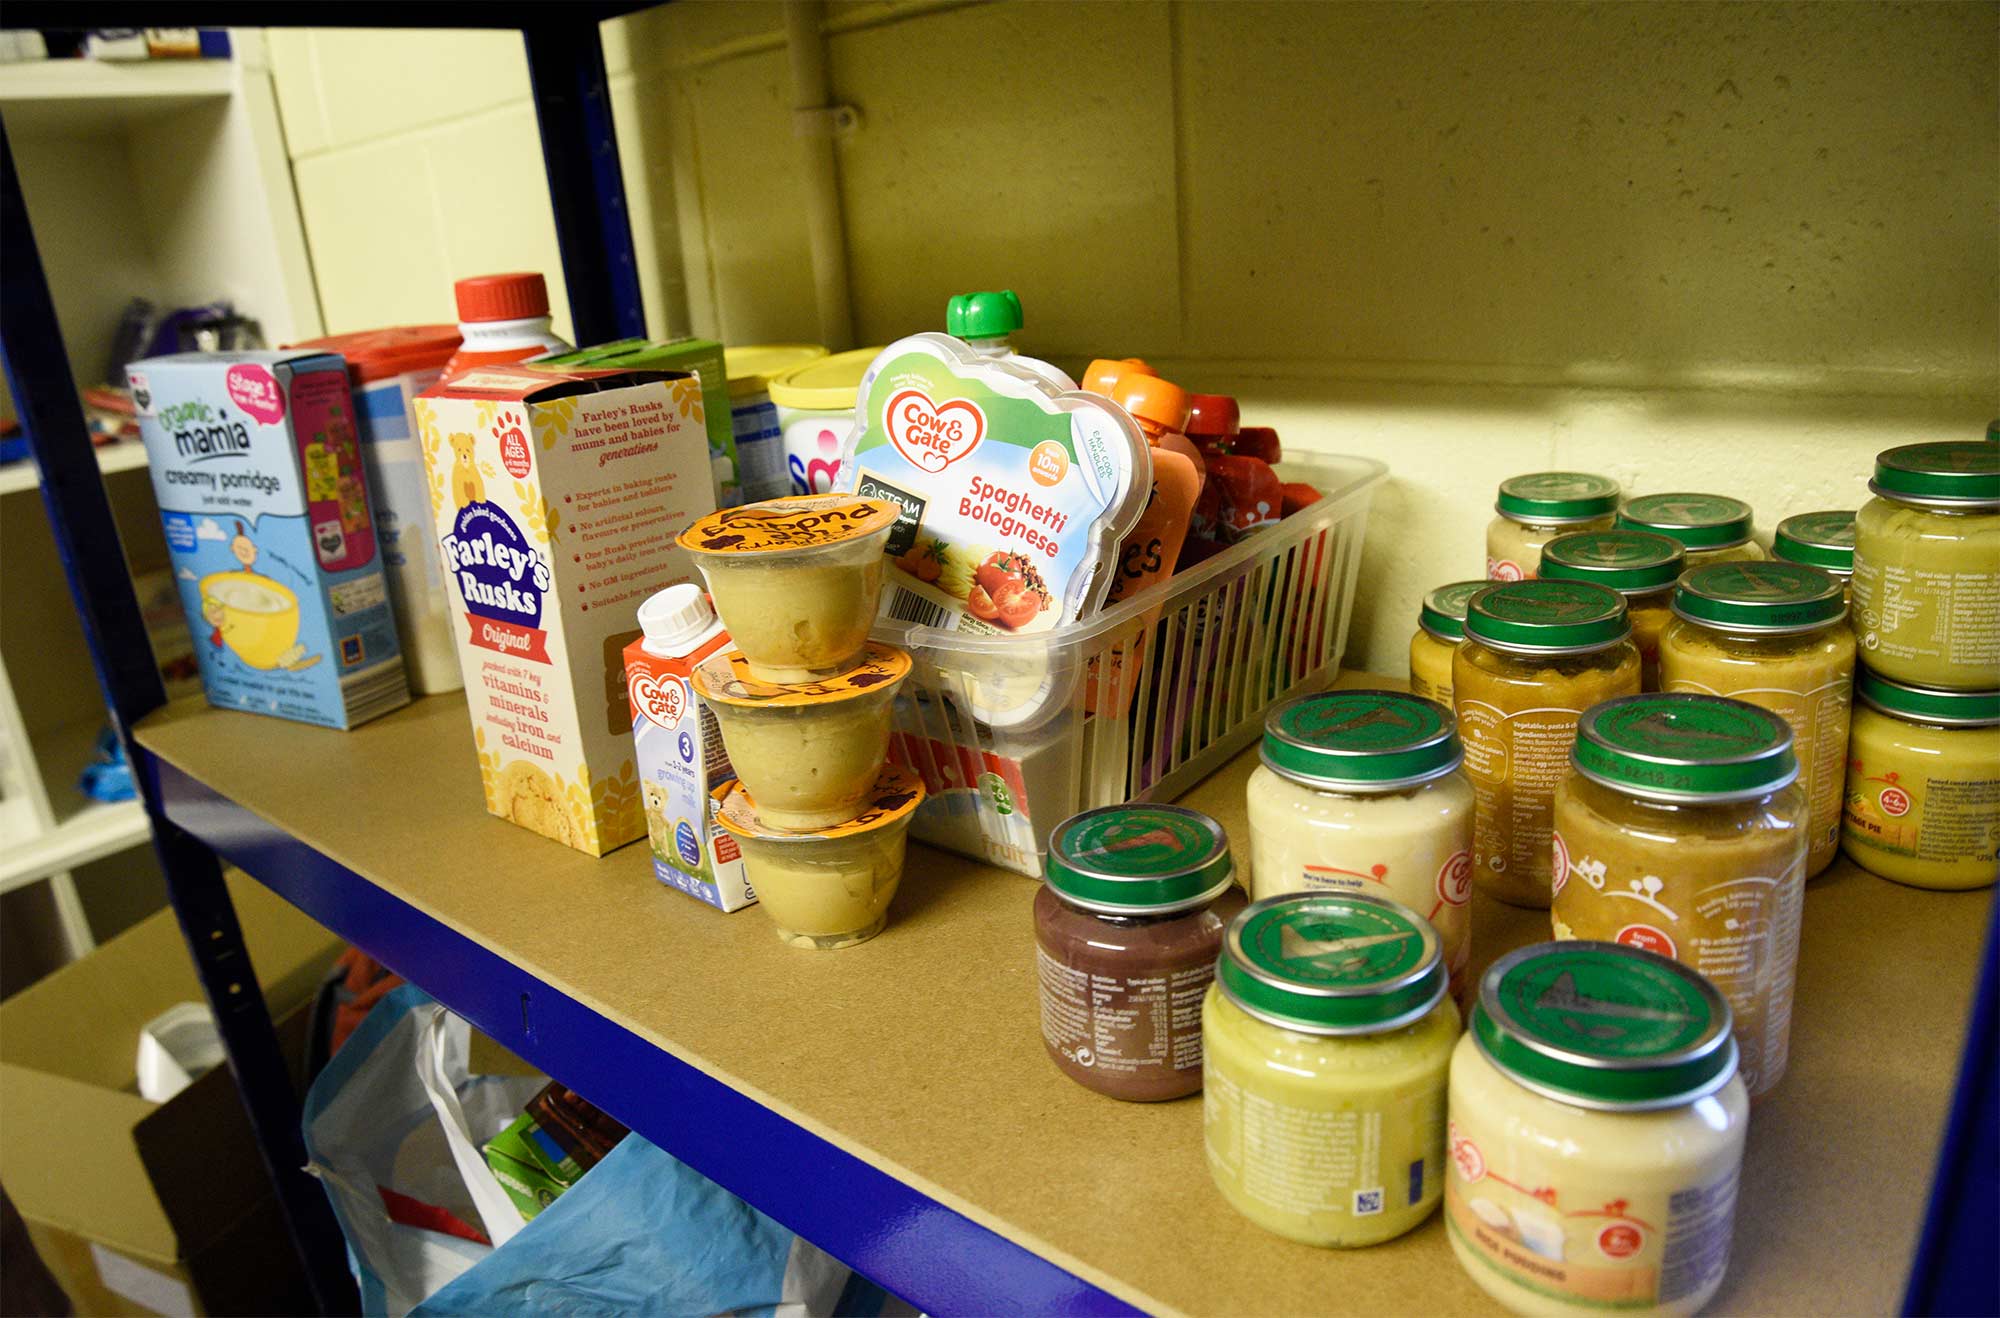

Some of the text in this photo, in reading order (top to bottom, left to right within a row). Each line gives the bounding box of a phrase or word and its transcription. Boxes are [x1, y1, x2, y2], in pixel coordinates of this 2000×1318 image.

[229, 371, 264, 395] Stage
[267, 380, 277, 400] 1
[159, 398, 215, 432] organic
[574, 411, 674, 439] have been loved by
[582, 401, 663, 423] Farley's Rusks
[904, 403, 963, 441] Cow &
[174, 410, 250, 457] mamia
[506, 433, 521, 447] ALL
[571, 422, 681, 452] mums and babies for
[905, 425, 951, 454] Gate
[504, 446, 526, 459] AGES
[598, 442, 658, 468] generations
[1036, 453, 1060, 474] 10m
[1087, 438, 1107, 478] HANDLES
[1092, 430, 1114, 480] EASY COOL
[165, 469, 281, 496] creamy porridge
[575, 471, 678, 502] Experts in baking rusks
[577, 484, 673, 513] for babies and toddlers
[969, 476, 1068, 533] Spaghetti
[580, 521, 594, 531] No
[595, 511, 633, 529] artificial
[581, 526, 619, 542] flavours
[631, 511, 686, 532] preservatives
[959, 497, 1059, 558] Bolognese
[584, 550, 602, 561] One
[603, 543, 627, 556] Rusk
[629, 535, 664, 551] provides
[585, 558, 615, 572] baby's
[616, 552, 638, 564] daily
[441, 532, 550, 593] Farley's
[588, 563, 668, 591] No GM ingredients
[460, 571, 537, 616] Rusks
[591, 593, 628, 609] Suitable
[630, 589, 642, 598] for
[482, 623, 532, 652] Original
[482, 673, 542, 703] vitamins
[523, 669, 528, 680] 7
[641, 683, 680, 705] Cow &
[648, 700, 678, 716] Gate
[489, 694, 549, 723] minerals
[516, 717, 545, 740] iron
[501, 733, 555, 761] calcium
[682, 737, 691, 758] 3
[657, 768, 686, 790] growing
[681, 765, 696, 778] years
[1867, 823, 1882, 834] PIE
[1631, 931, 1657, 944] from
